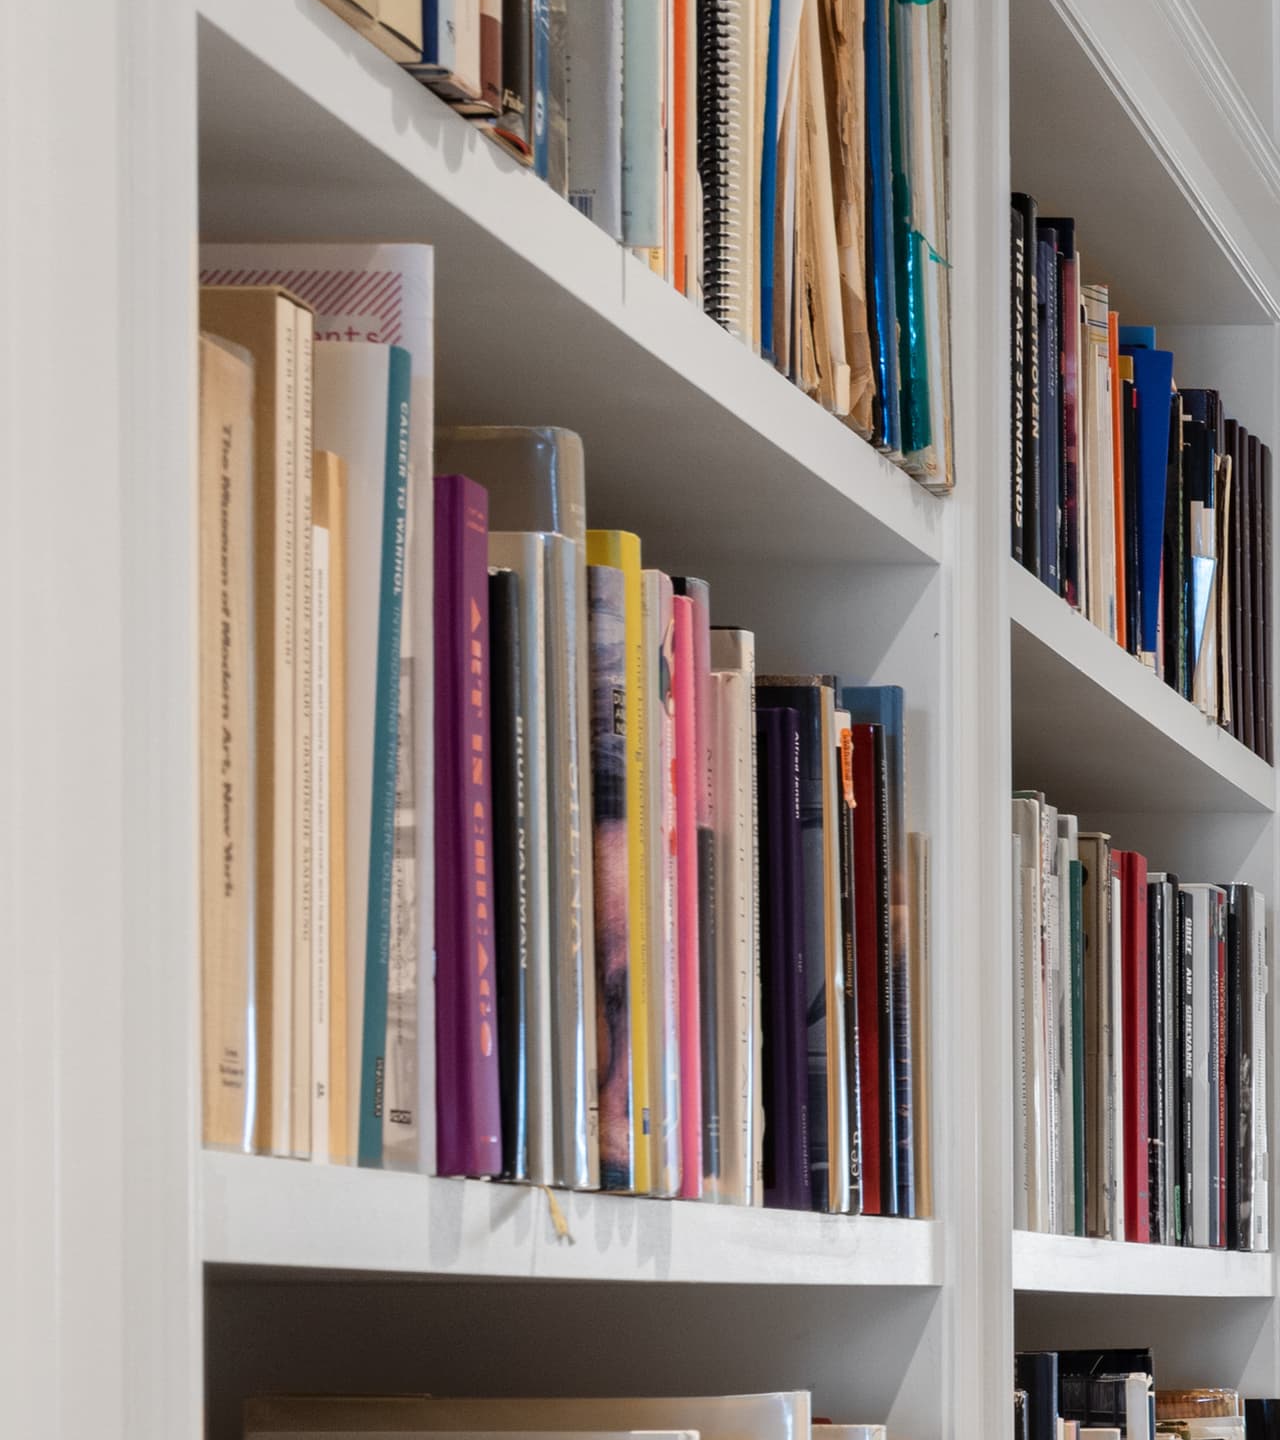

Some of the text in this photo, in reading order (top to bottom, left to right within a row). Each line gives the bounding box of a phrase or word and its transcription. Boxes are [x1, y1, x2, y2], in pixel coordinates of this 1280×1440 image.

[1031, 275, 1039, 439] BEETHOVEN
[221, 424, 233, 468] The
[398, 403, 408, 475] CALDER
[221, 473, 232, 585] Museum
[393, 518, 404, 595] WARHOL
[221, 621, 233, 719] Modern
[220, 728, 233, 775] Art,
[222, 782, 233, 839] New
[515, 716, 527, 970] BRUCE NAUMAN
[223, 841, 233, 898] York
[379, 850, 392, 963] COLLECTION
